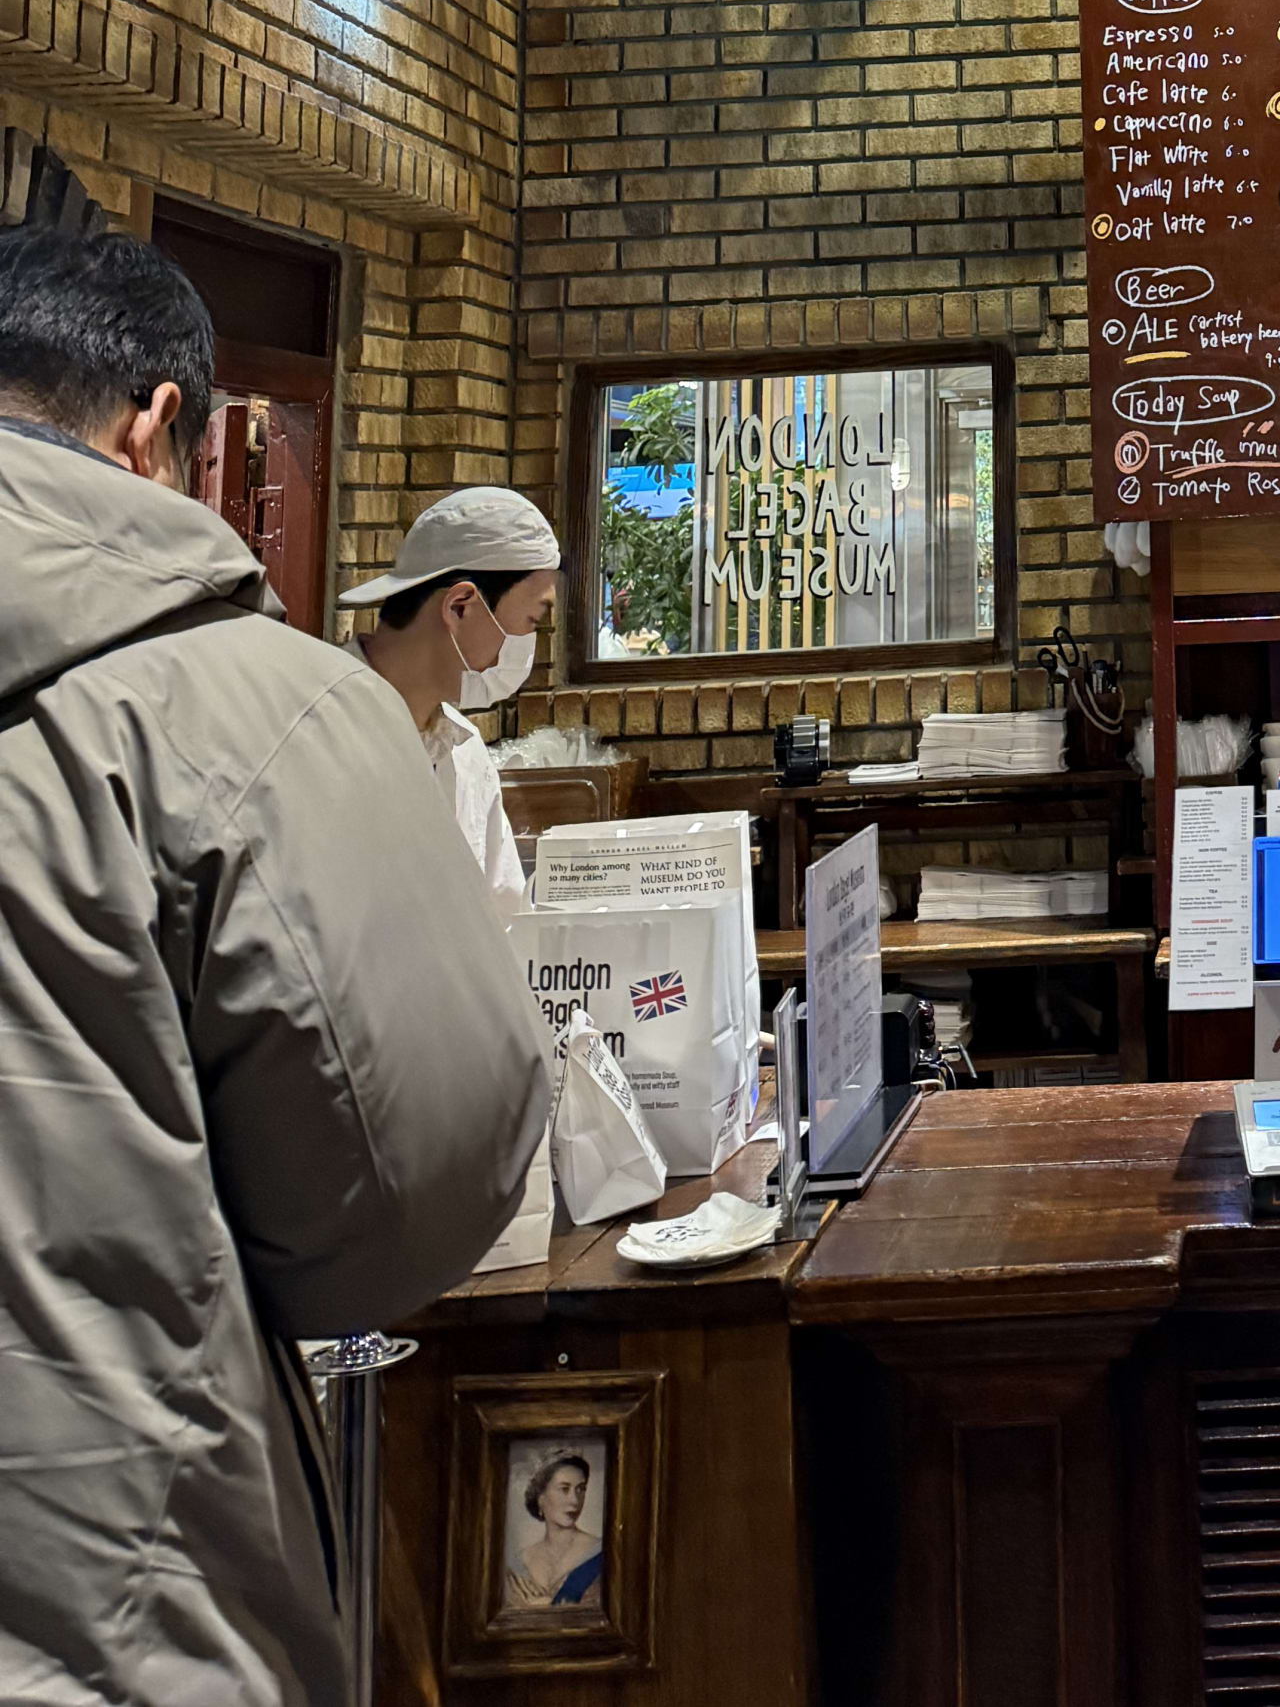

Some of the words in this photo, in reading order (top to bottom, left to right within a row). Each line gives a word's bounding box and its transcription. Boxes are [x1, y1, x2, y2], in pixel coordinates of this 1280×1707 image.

[1103, 25, 1193, 50] Espresso
[1106, 52, 1209, 75] Americano
[1102, 80, 1149, 106] Cafe
[1162, 78, 1208, 104] latte
[1108, 146, 1151, 172] Flat
[1116, 178, 1172, 206] Vanilla
[1185, 174, 1225, 198] latte
[1163, 212, 1206, 235] latte
[1226, 216, 1253, 230] 7.0
[1127, 276, 1185, 306] Beer
[1128, 312, 1179, 351] ALE
[1200, 332, 1252, 354] bakery
[1120, 385, 1184, 436] Today
[1198, 386, 1240, 415] Soup
[1150, 438, 1226, 472] Truffle
[1152, 476, 1230, 506] Tomato
[550, 863, 568, 874] Why
[571, 862, 599, 872] London
[601, 862, 631, 872] among
[640, 861, 672, 872] WHAT
[675, 858, 702, 869] KIND
[705, 856, 717, 866] OF
[641, 873, 684, 884] MUSEUM
[687, 871, 703, 881] DO
[704, 867, 726, 879] YOU
[548, 874, 557, 882] so
[560, 874, 581, 883] many
[583, 872, 608, 882] cities?
[640, 885, 671, 895] WANT
[711, 880, 725, 890] TO
[528, 957, 611, 992] London
[534, 991, 589, 1033] agel
